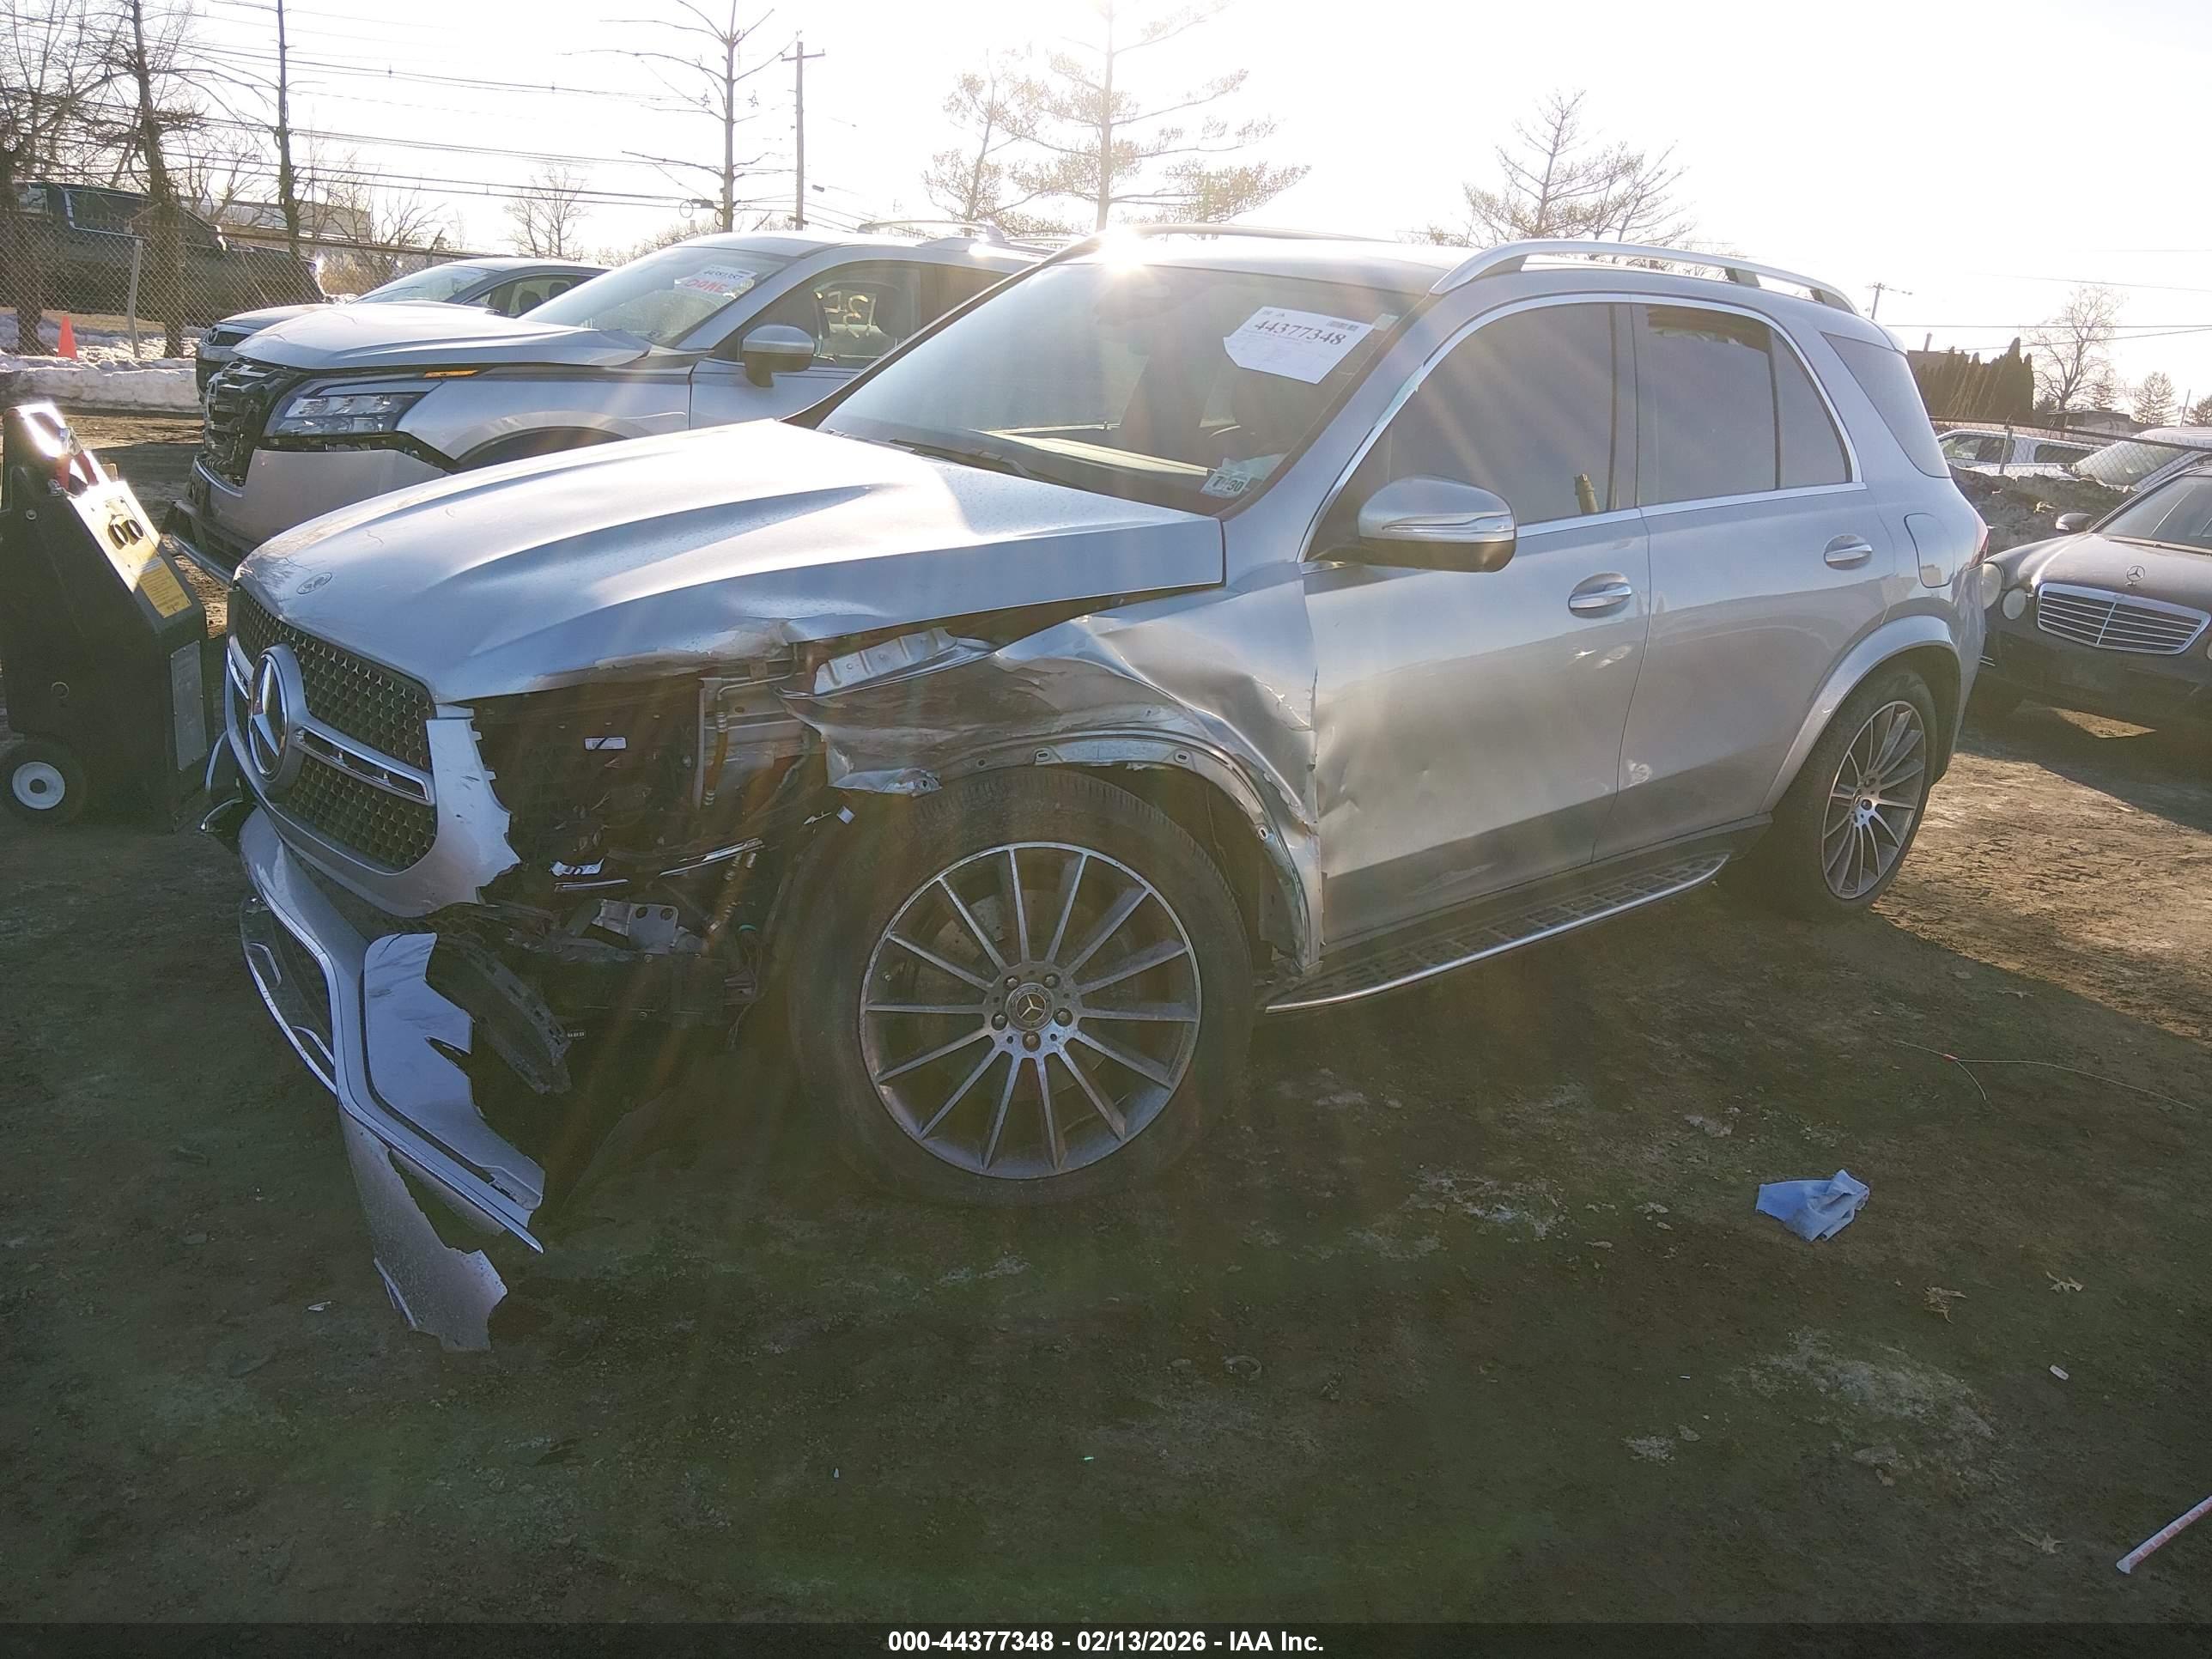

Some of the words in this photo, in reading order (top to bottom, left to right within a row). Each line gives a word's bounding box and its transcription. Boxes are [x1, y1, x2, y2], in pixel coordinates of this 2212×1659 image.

[686, 278, 729, 294] DONE
[1255, 319, 1347, 345] 44377348
[1225, 479, 1245, 492] 30
